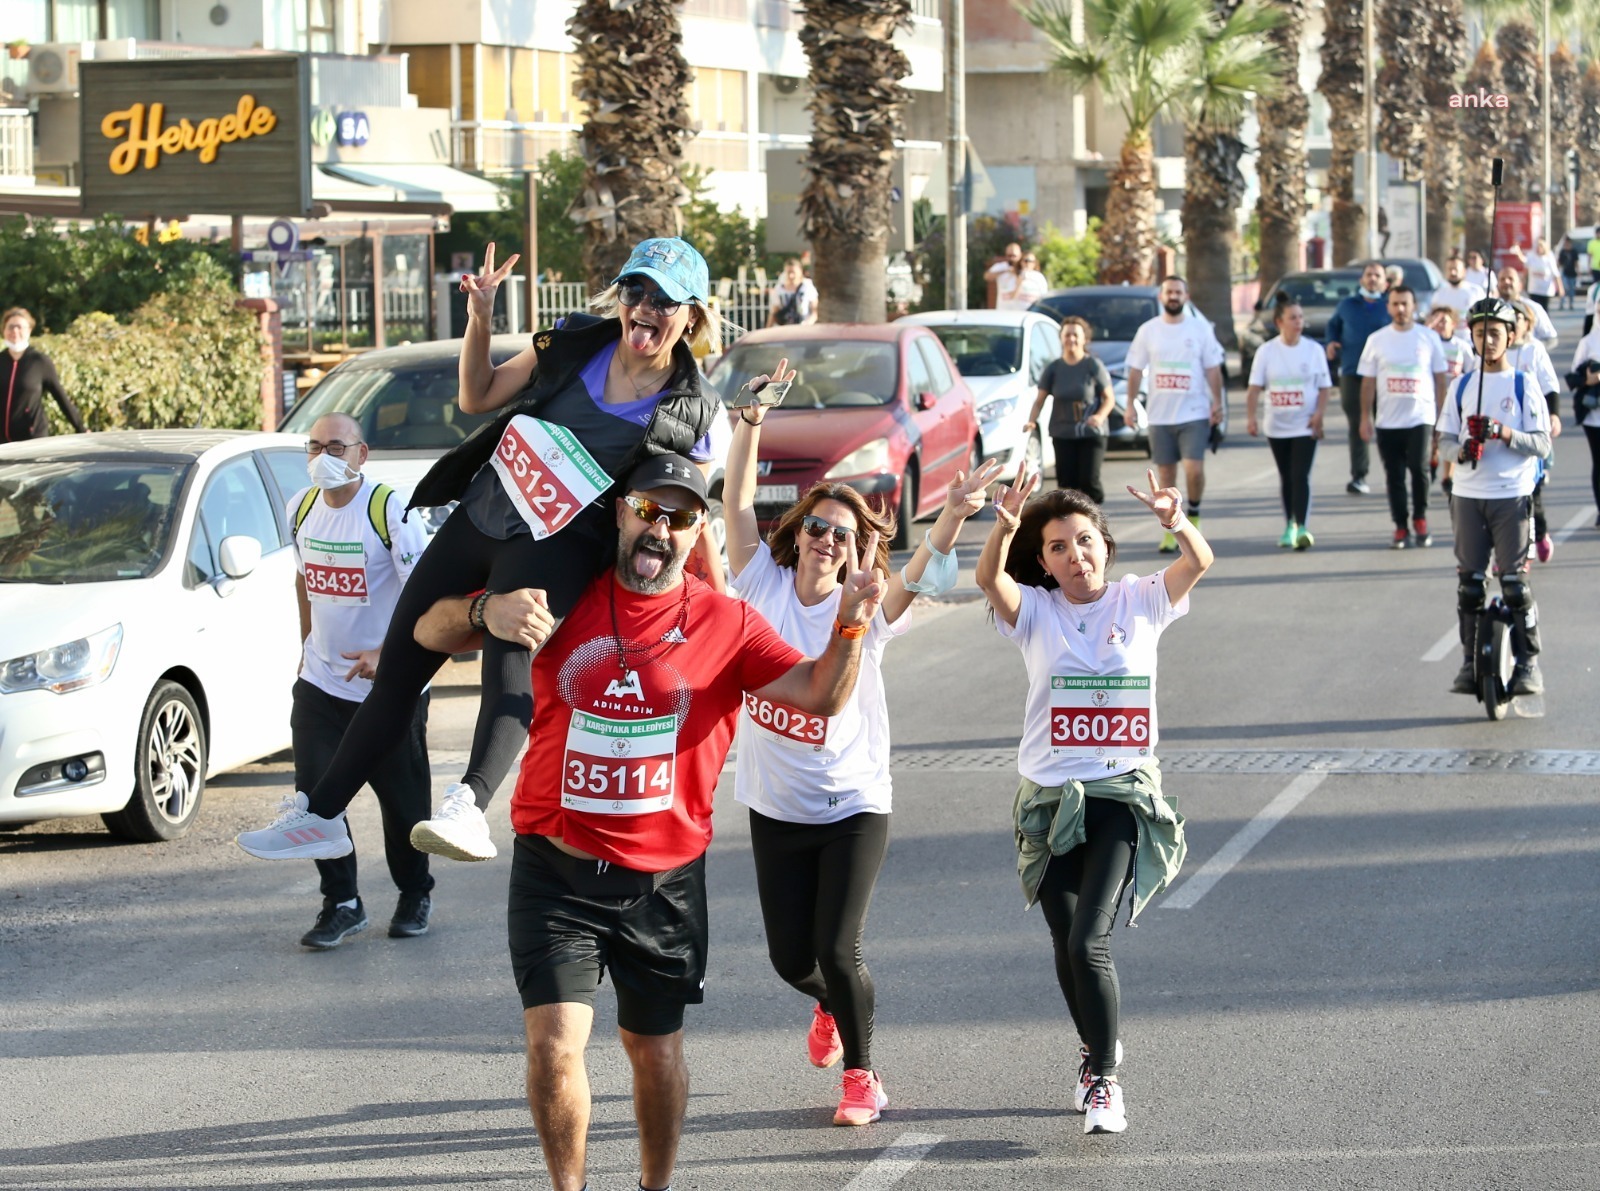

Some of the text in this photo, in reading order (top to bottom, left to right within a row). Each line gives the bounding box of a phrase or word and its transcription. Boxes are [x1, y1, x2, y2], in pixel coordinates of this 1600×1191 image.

[101, 94, 277, 175] Hergele
[342, 117, 369, 140] SA
[500, 434, 572, 527] 35121
[769, 487, 796, 499] 1102
[306, 568, 366, 593] 35432
[1067, 678, 1148, 688] KARŞIYAKA BELEDİYESİ
[593, 700, 653, 715] ADIM ADIM
[746, 693, 825, 741] 36023
[586, 719, 674, 734] KARŞIYAKA BELEDİYESİ
[1053, 714, 1148, 742] 36026
[567, 759, 670, 795] 35114
